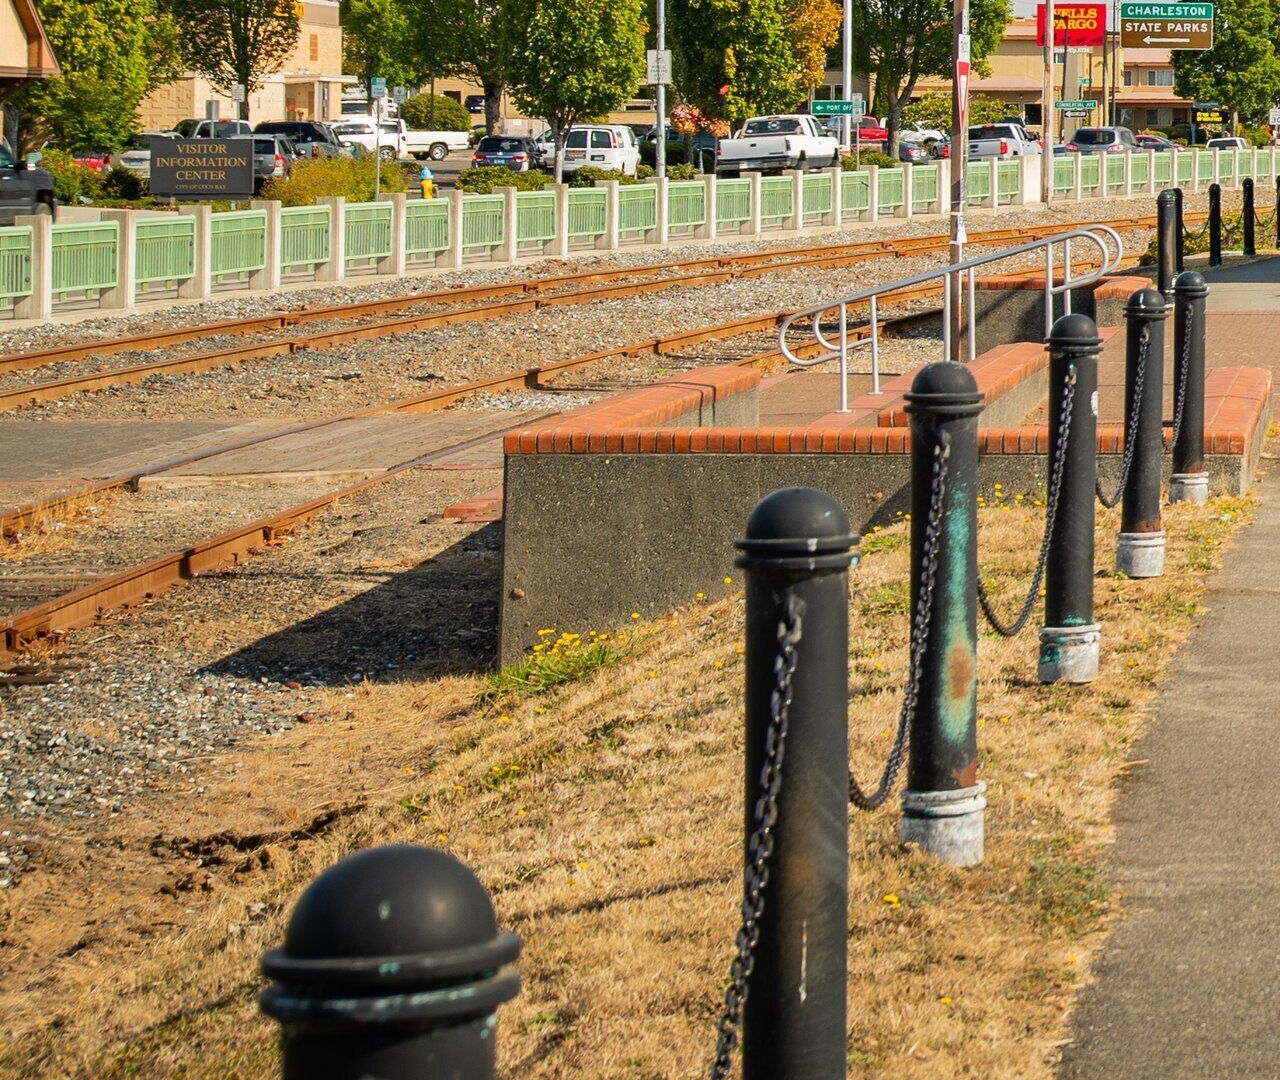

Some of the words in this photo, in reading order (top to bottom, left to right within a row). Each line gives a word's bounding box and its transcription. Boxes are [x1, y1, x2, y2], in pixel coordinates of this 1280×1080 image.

[1127, 6, 1206, 16] CHARLESTON
[1125, 22, 1161, 32] STATE
[1167, 22, 1208, 32] PARKS
[177, 144, 227, 153] VISITOR
[156, 157, 247, 167] INFORMATION
[175, 170, 226, 180] CENTER
